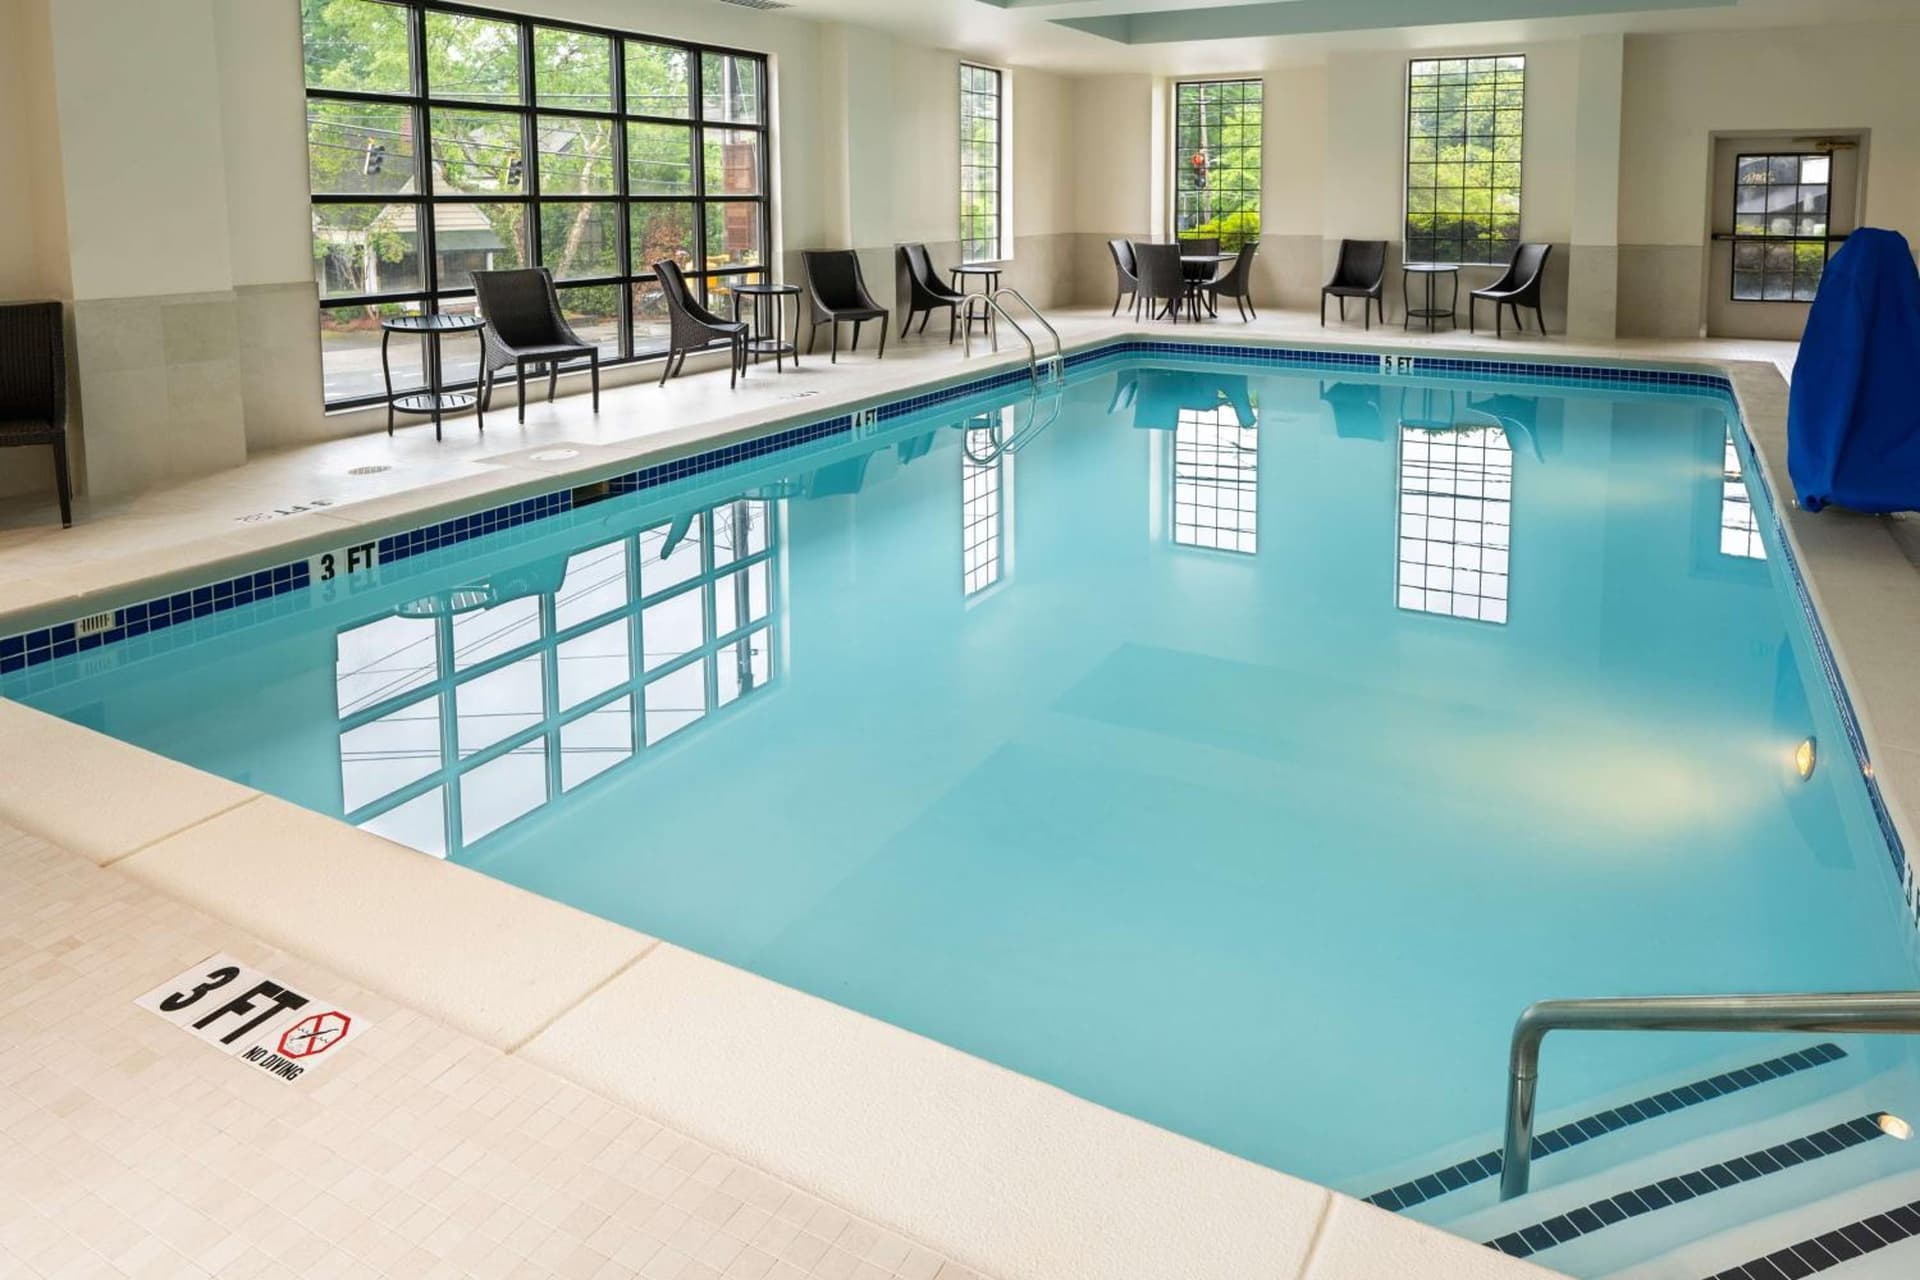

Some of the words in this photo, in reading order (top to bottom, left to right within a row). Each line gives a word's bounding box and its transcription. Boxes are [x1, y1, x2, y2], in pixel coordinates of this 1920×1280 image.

[1398, 356, 1412, 369] FT
[855, 411, 861, 427] 4
[865, 407, 876, 426] FT
[321, 553, 335, 581] 3
[347, 541, 375, 574] FT
[159, 966, 240, 1012] 3
[192, 980, 310, 1045] FT
[241, 1045, 268, 1062] NO
[259, 1054, 304, 1081] DIVING
